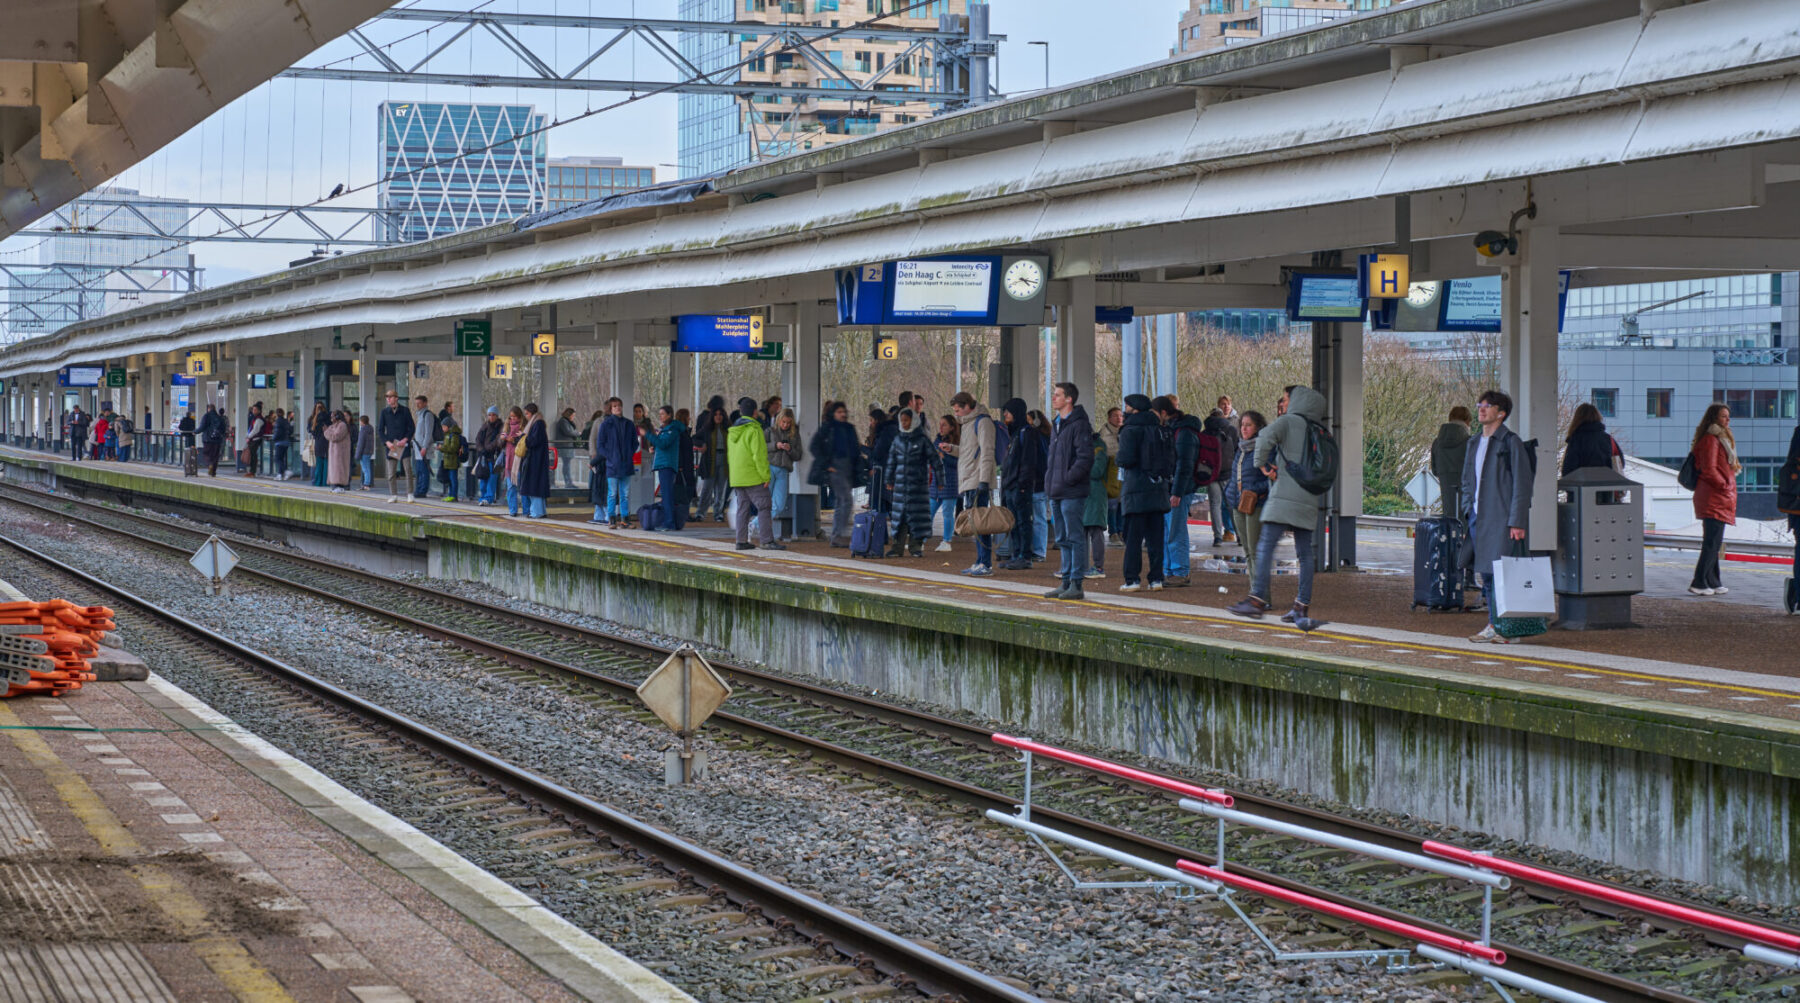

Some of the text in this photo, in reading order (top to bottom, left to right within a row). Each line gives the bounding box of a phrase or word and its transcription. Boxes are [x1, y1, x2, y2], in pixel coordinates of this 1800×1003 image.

[396, 108, 407, 117] EY
[952, 263, 974, 272] Intercity
[898, 270, 943, 281] Den Haag C.
[1381, 270, 1398, 293] H
[539, 342, 550, 354] G
[883, 346, 893, 358] G
